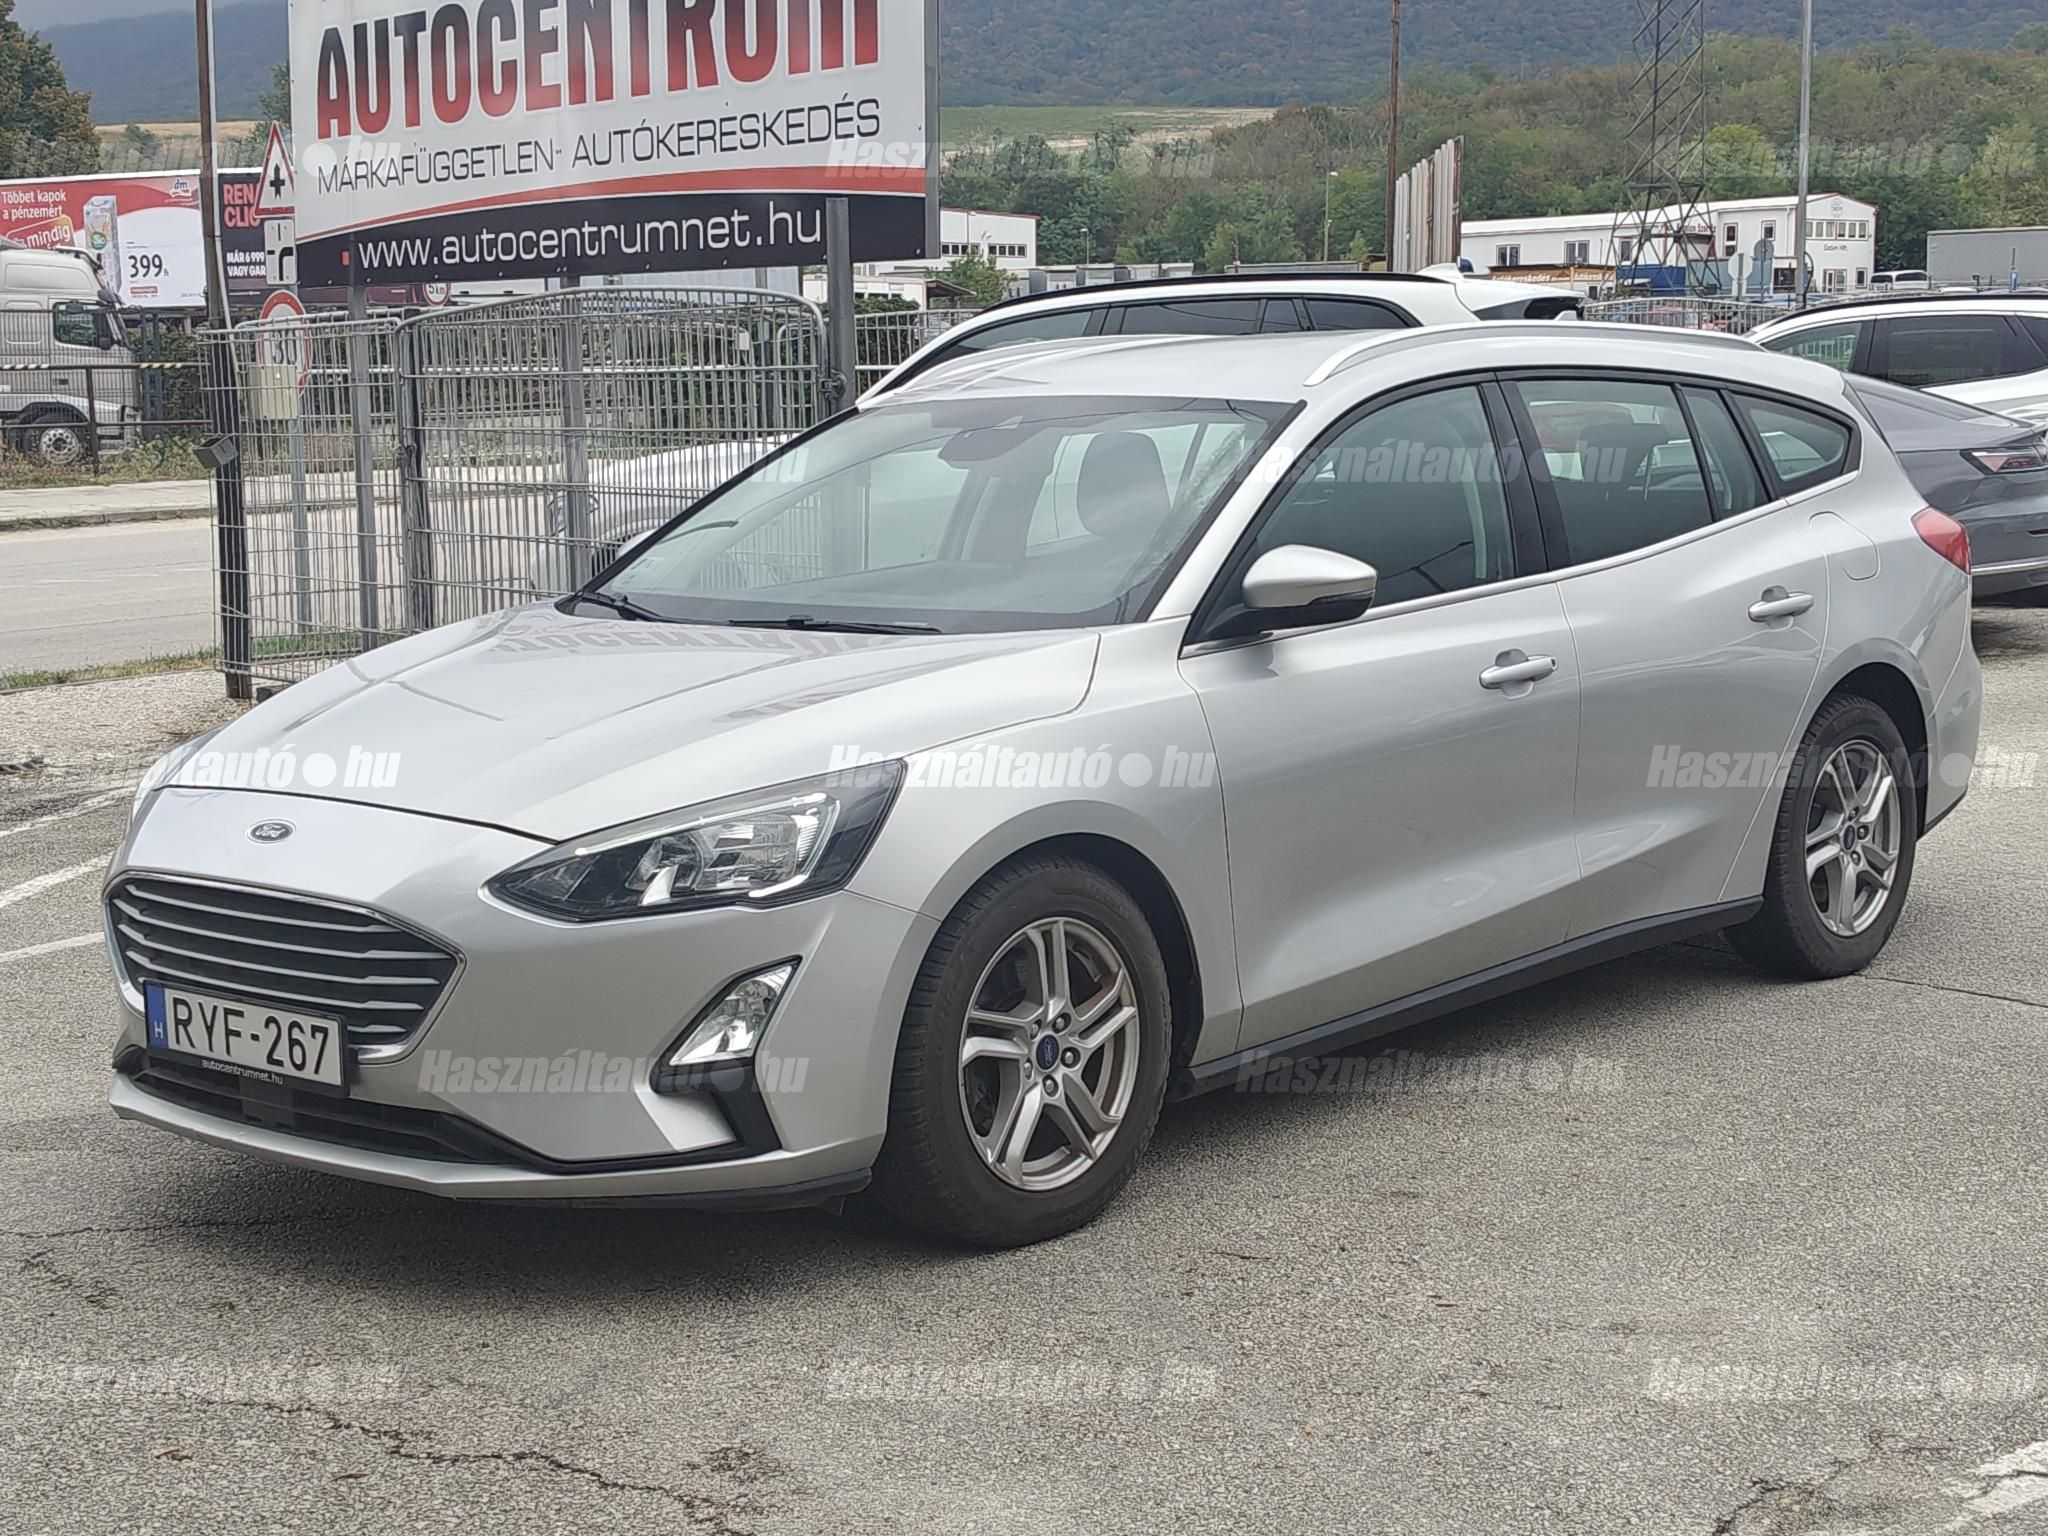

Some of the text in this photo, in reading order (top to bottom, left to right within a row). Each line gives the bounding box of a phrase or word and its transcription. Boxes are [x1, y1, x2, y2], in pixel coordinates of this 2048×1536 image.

[317, 0, 879, 140] AUTOCENTRUM
[572, 92, 880, 168] AUTÓKERESKEDÉS
[1, 189, 67, 204] Többet kapok
[223, 183, 259, 205] REN
[3, 204, 63, 222] a pénzemért
[27, 225, 71, 248] mindig
[359, 200, 821, 269] www.autocentrumnet.hu
[128, 253, 163, 278] 399
[227, 249, 246, 263] MÁR
[227, 265, 249, 277] VAGY
[153, 1020, 164, 1039] H
[171, 996, 329, 1075] RYF-267
[201, 1058, 284, 1085] autocentrumnet.hu
